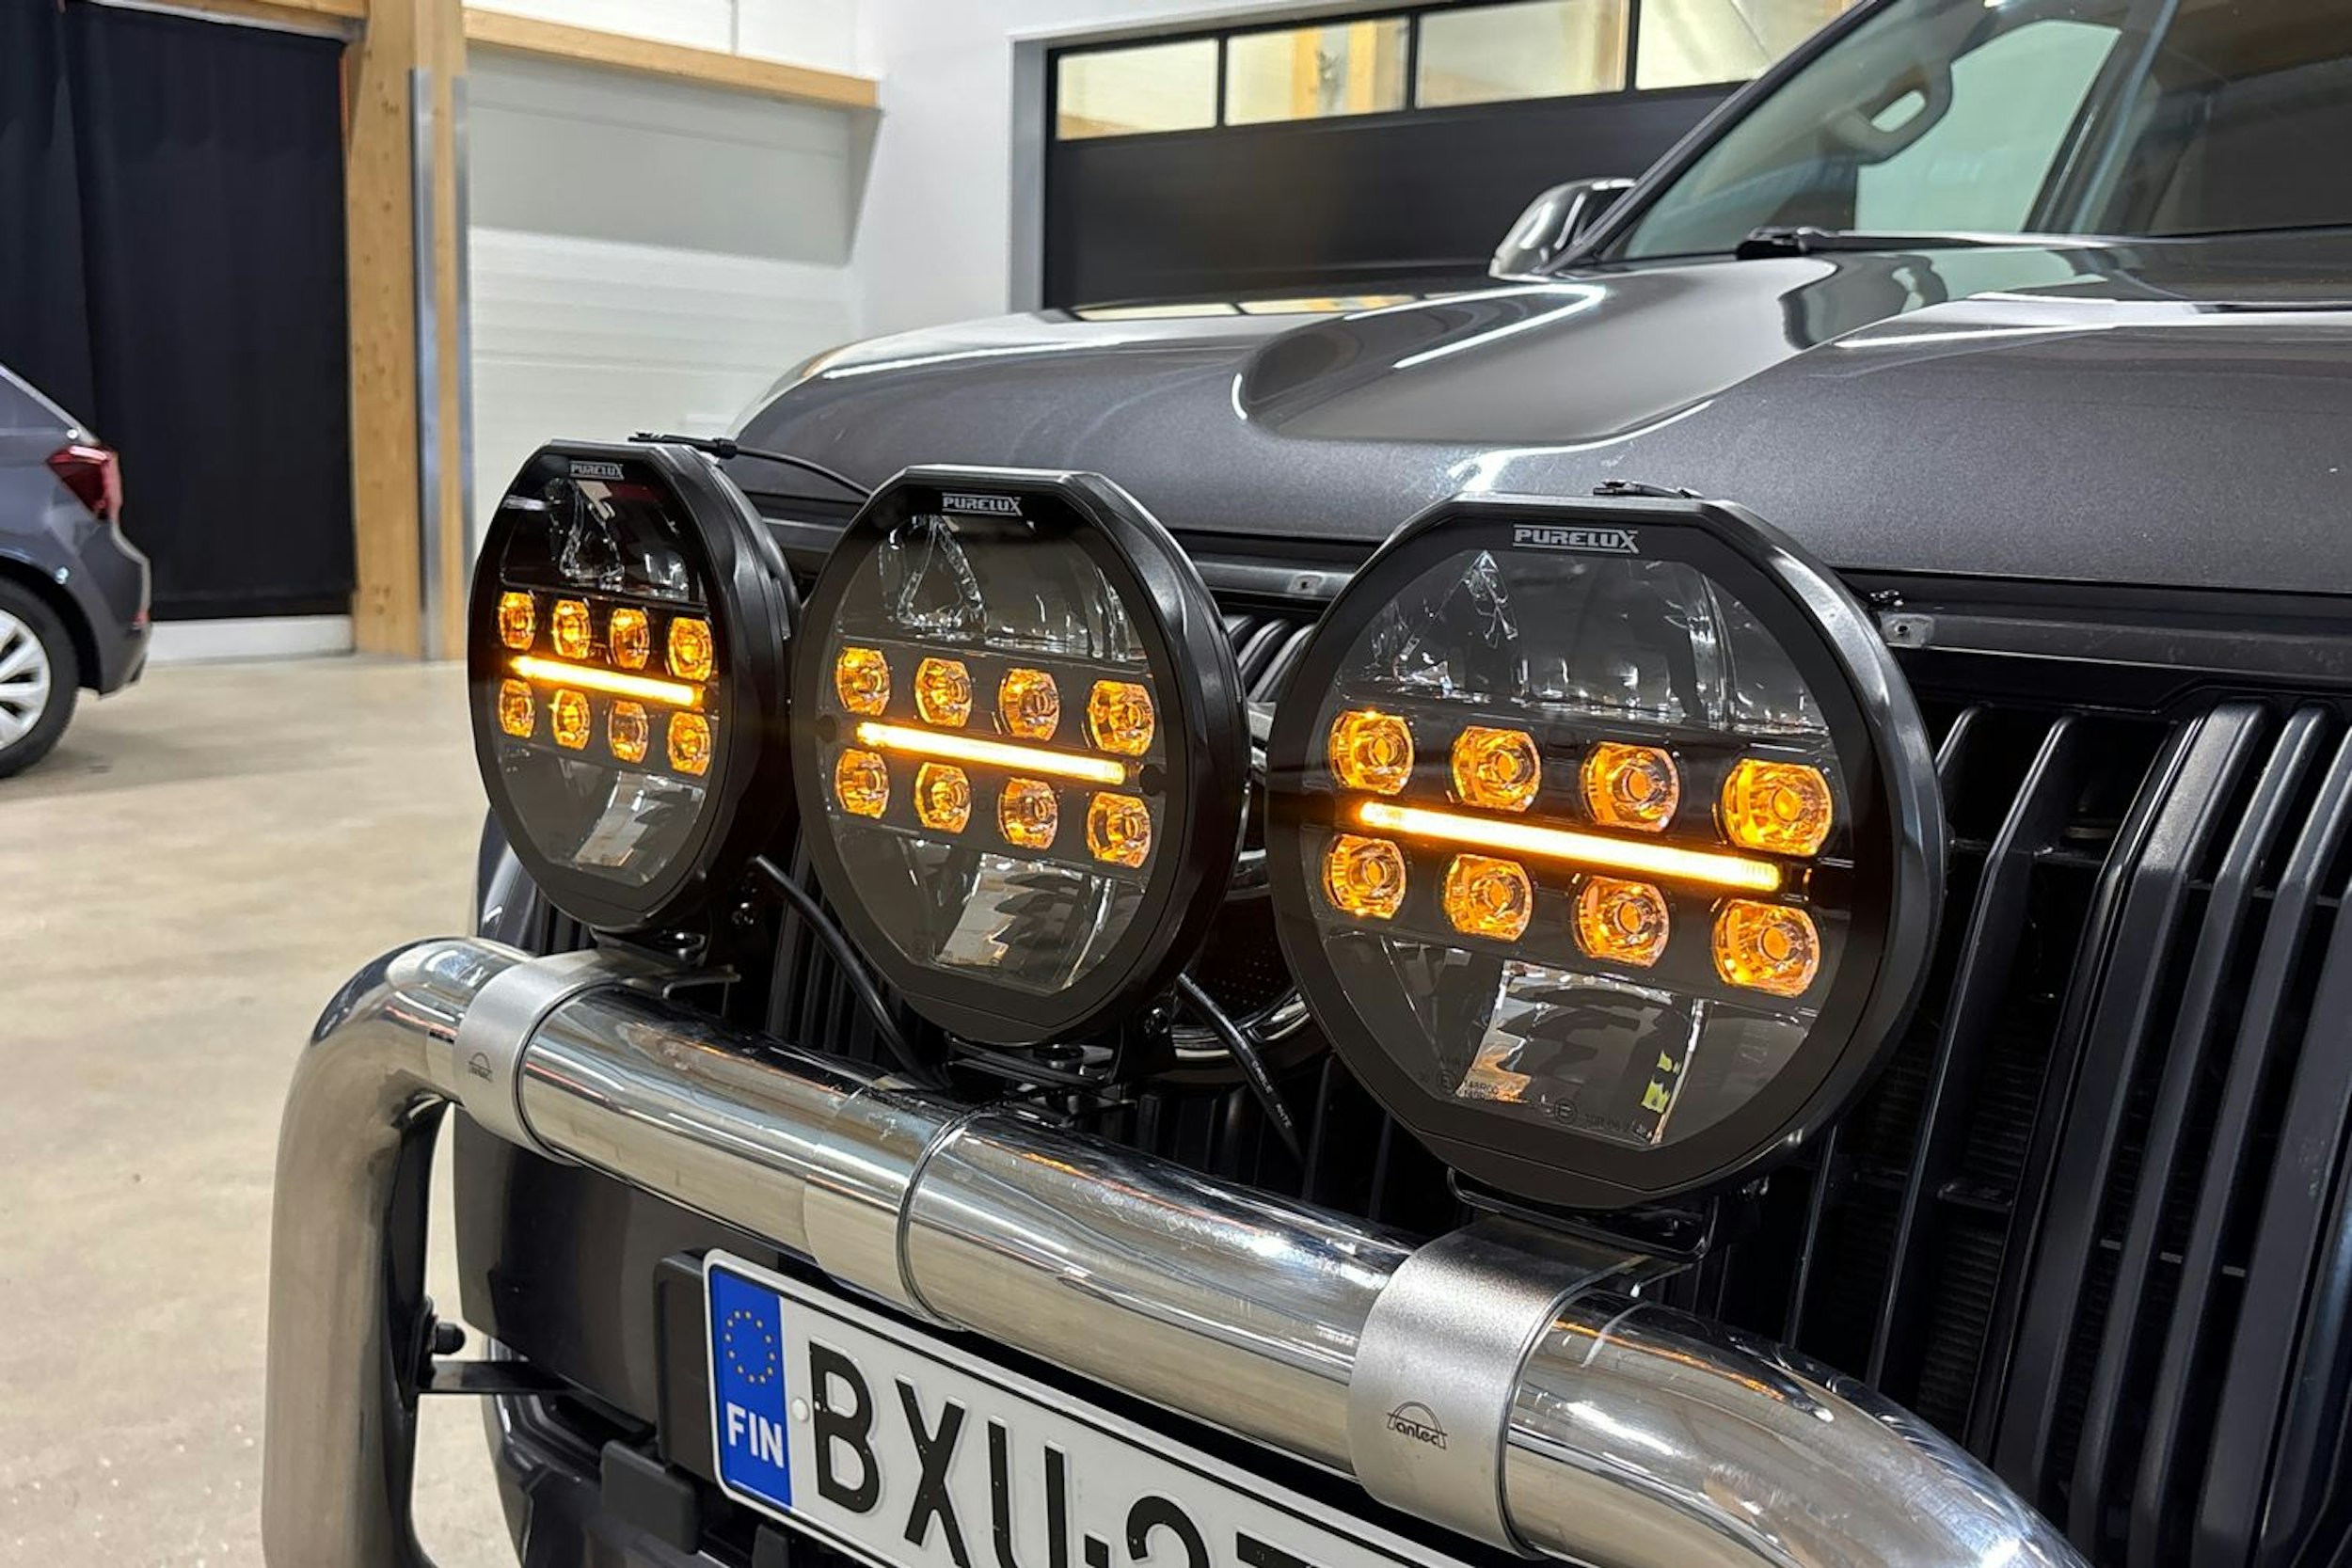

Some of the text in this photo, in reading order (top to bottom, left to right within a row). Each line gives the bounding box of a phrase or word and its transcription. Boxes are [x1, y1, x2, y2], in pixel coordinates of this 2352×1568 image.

[569, 462, 625, 481] PURELUX
[942, 495, 1023, 516] PURELUX
[1514, 527, 1639, 554] PURELUX
[726, 1401, 785, 1469] FIN
